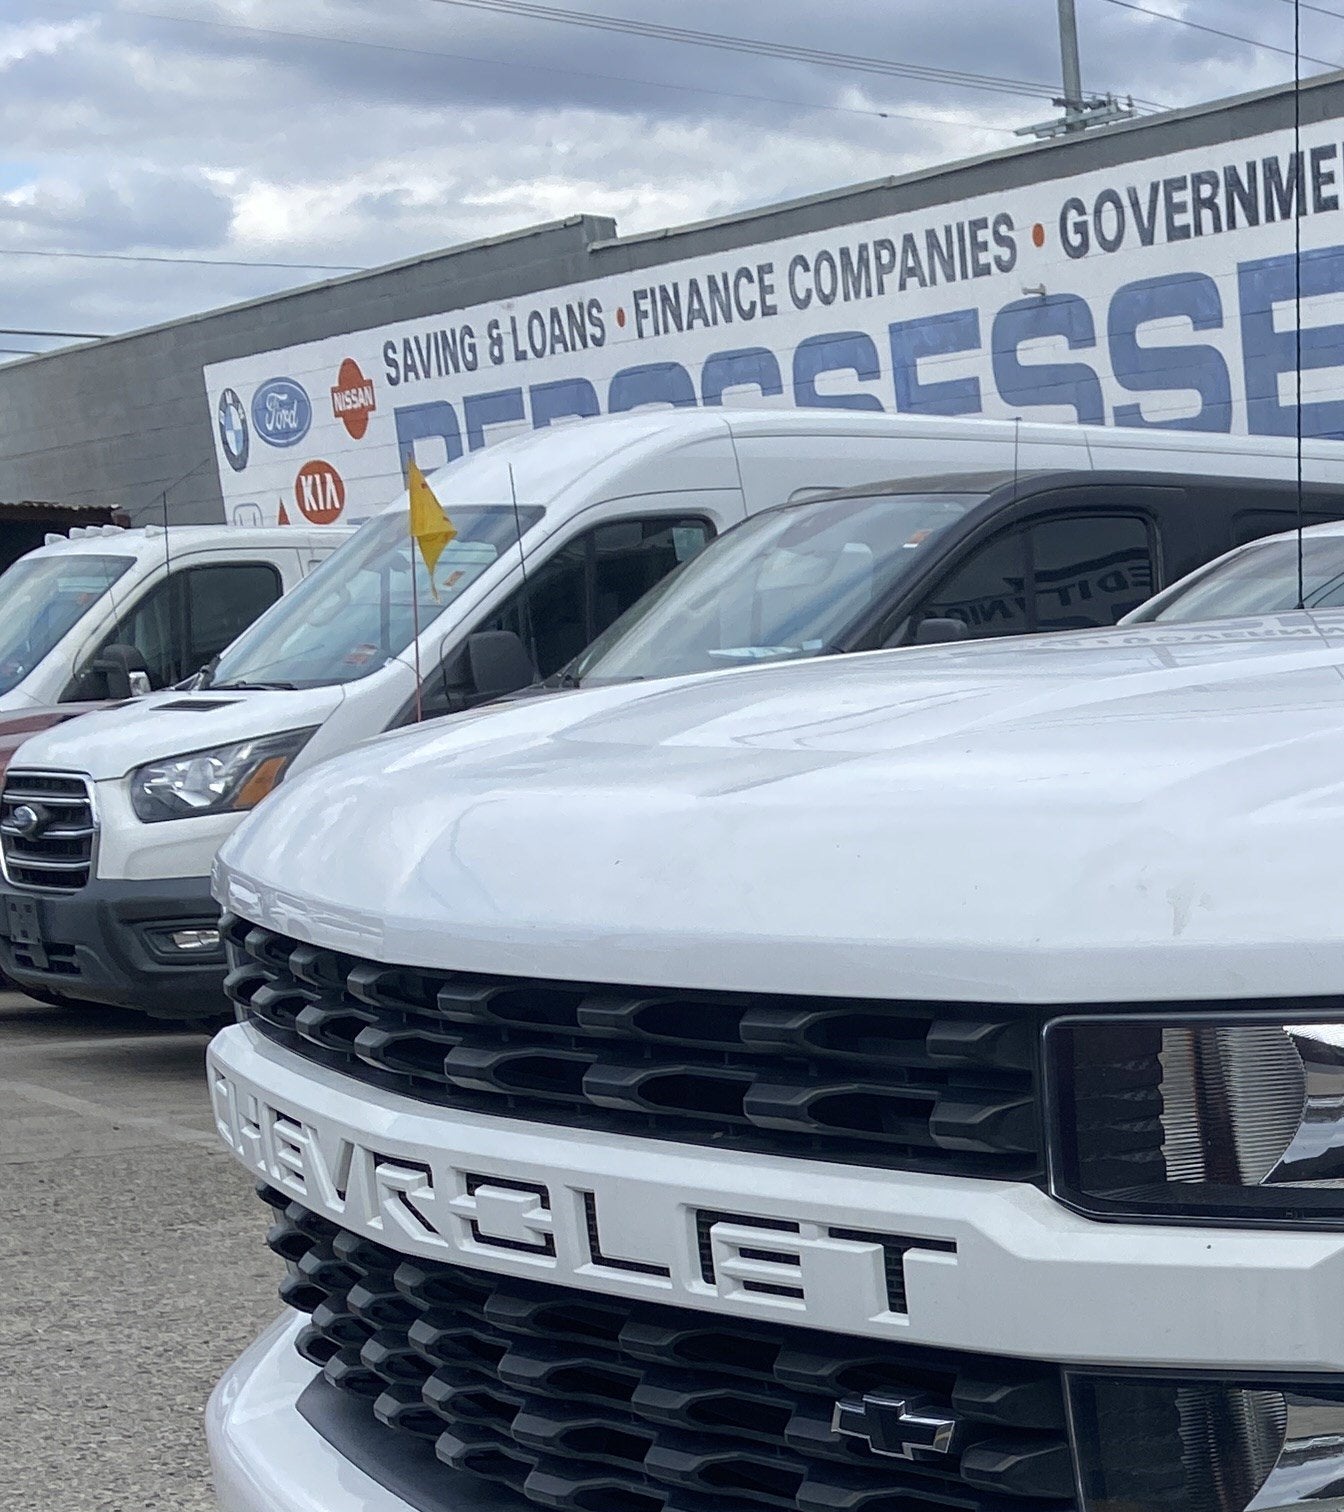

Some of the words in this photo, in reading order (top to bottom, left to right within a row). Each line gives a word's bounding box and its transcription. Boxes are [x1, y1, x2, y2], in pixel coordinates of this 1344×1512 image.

[382, 323, 478, 387] SAVING
[488, 318, 503, 365] &
[508, 297, 606, 360] LOANS
[633, 261, 778, 339] FINANCE
[788, 211, 1018, 310] COMPANIES
[265, 393, 299, 431] Ford
[333, 385, 374, 412] NISSAN
[299, 472, 340, 512] KIA
[209, 1066, 958, 1327] CHEVROLET
